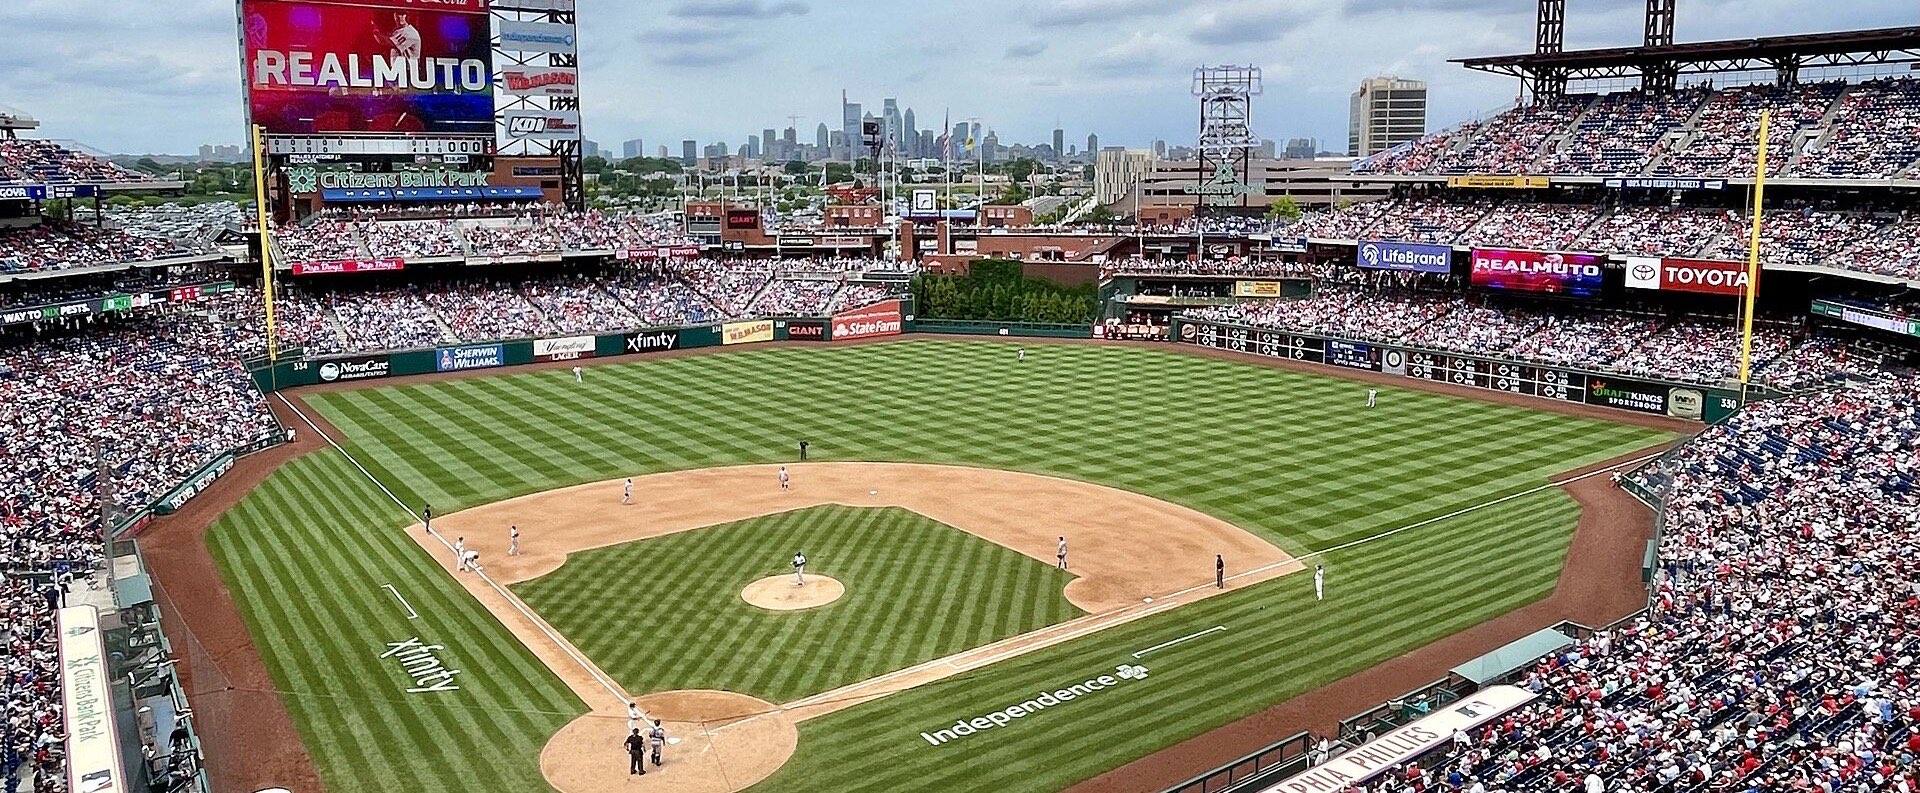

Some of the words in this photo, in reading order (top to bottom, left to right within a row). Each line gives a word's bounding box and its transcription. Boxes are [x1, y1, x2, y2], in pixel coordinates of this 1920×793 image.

[256, 50, 486, 91] REALMUTO
[510, 116, 547, 134] KDI
[321, 171, 398, 189] Citizens
[400, 169, 448, 188] Bank
[449, 170, 489, 187] Park
[630, 250, 658, 258] TOYOTA
[671, 248, 698, 256] TOYOTA
[1382, 250, 1446, 266] LifeBrand
[1474, 257, 1600, 277] REALMUTO
[1665, 266, 1750, 288] TOYOTA
[4, 309, 28, 324] WAY
[28, 309, 42, 321] TO
[789, 326, 824, 336] GIANT
[627, 332, 677, 352] xfinity
[454, 347, 498, 359] SHERWIN
[293, 361, 308, 371] 334
[340, 360, 389, 374] NovaCare
[1608, 397, 1662, 411] SPORTSBOOK
[1720, 398, 1737, 410] 330
[380, 636, 460, 693] xfinity
[74, 668, 96, 700] Citizens
[77, 697, 104, 721] Bank
[920, 674, 1118, 746] Independence
[79, 719, 105, 743] Park
[1345, 726, 1439, 770] PHILLIES
